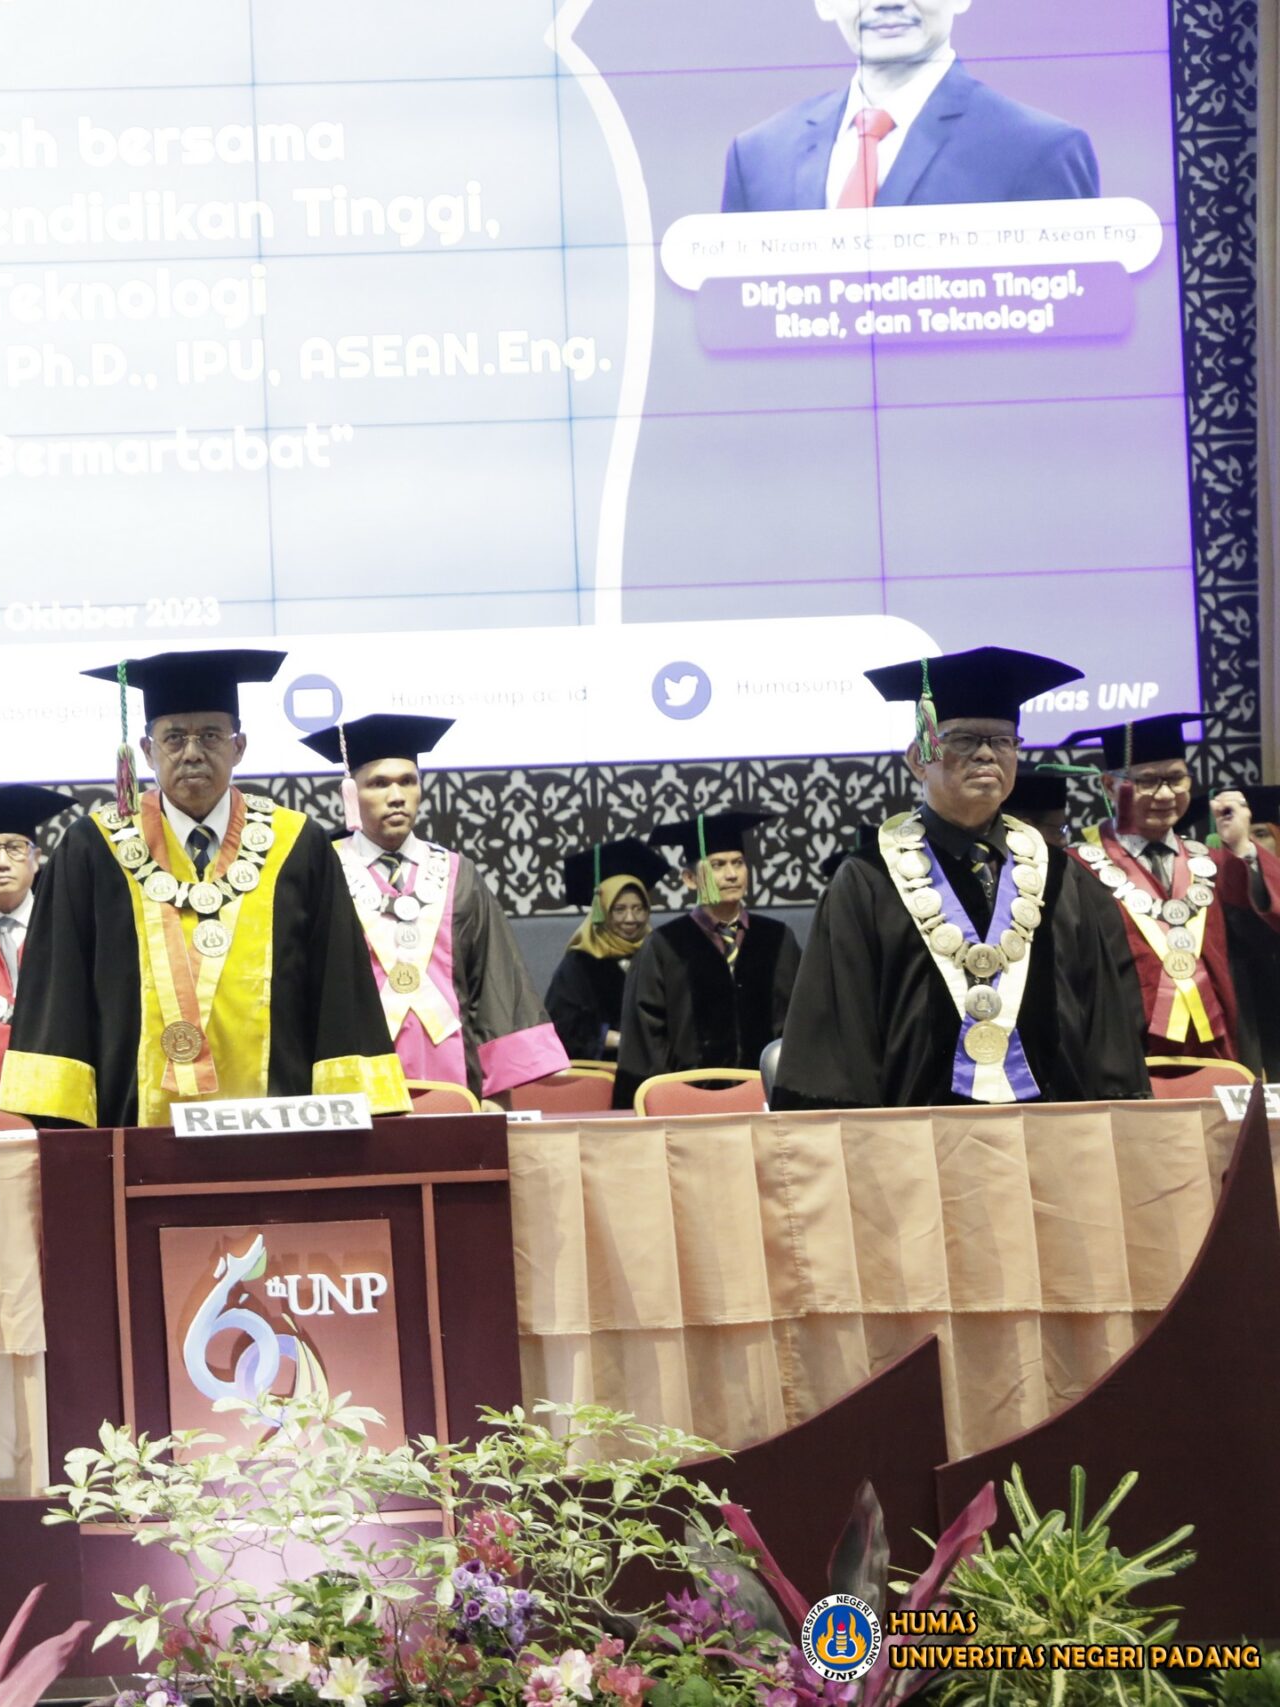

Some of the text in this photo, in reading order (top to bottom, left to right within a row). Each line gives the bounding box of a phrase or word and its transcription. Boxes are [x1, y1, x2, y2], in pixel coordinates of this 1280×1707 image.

[78, 116, 345, 167] bersama
[293, 180, 499, 247] Tinggi,
[741, 269, 1085, 310] Dirjen Pendidikan Tinggi,
[776, 303, 1054, 340] Riset, dan Teknologi
[6, 342, 158, 391] Ph.D.,
[176, 337, 282, 387] IPU,
[299, 329, 613, 382] ASEAN.Eng.
[3, 600, 138, 632] Oktober
[145, 596, 221, 628] 2023
[736, 679, 854, 696] Humasunp
[1020, 682, 1160, 713] mas UNP
[184, 1100, 360, 1132] REKTOR
[284, 1271, 388, 1316] UNP
